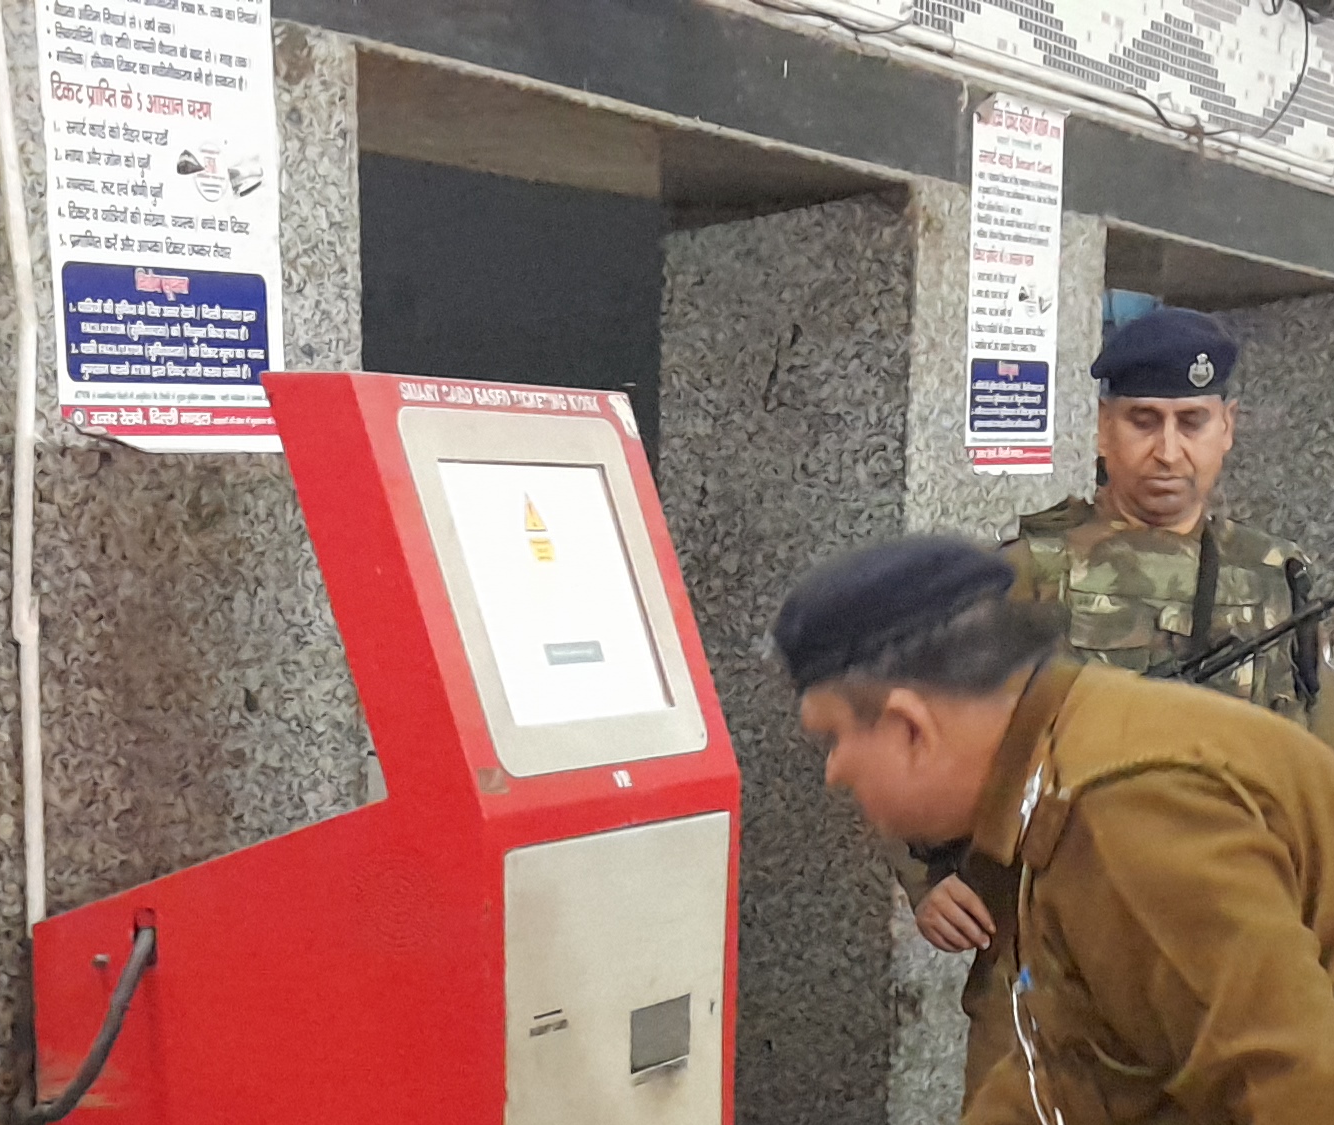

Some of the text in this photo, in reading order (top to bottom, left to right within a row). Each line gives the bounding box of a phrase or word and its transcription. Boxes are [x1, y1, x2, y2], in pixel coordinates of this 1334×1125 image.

[50, 71, 83, 103] टिकट
[86, 78, 117, 108] प्राप्ति
[120, 83, 133, 108] के
[146, 94, 183, 116] आसान
[187, 99, 212, 120] चरण
[149, 408, 178, 426] दिल्ली
